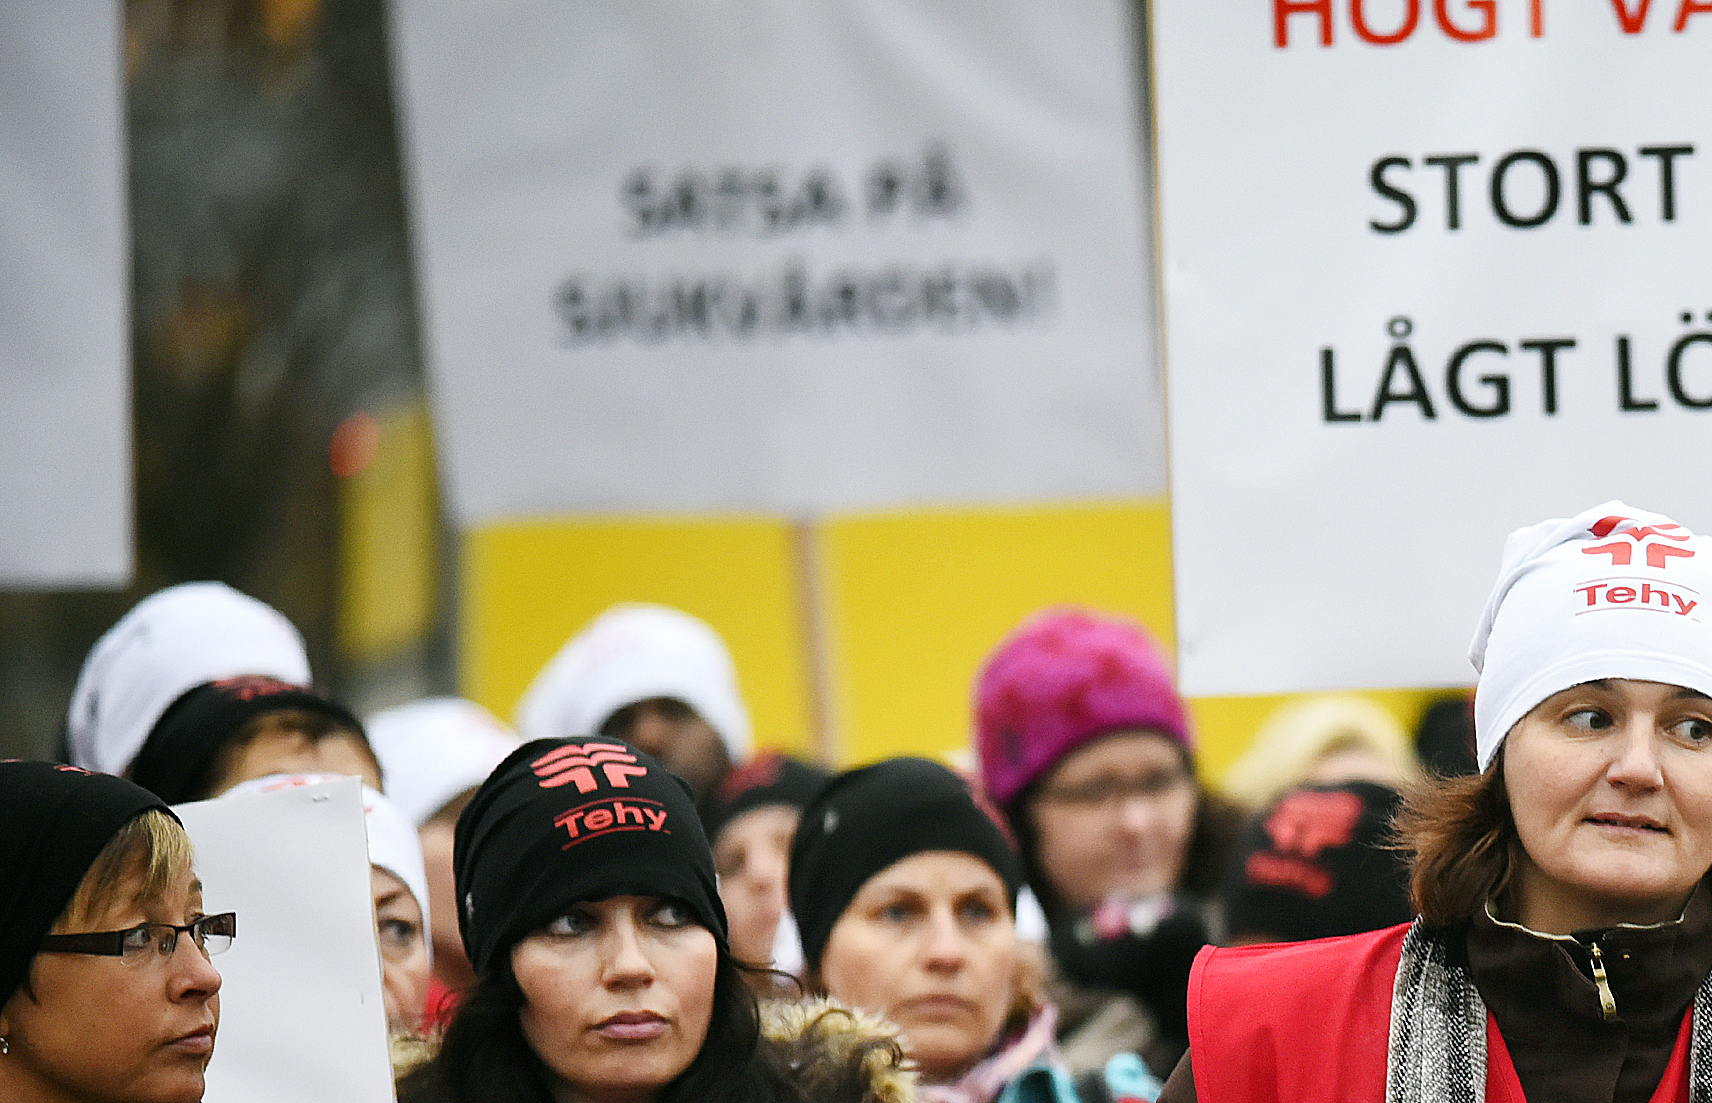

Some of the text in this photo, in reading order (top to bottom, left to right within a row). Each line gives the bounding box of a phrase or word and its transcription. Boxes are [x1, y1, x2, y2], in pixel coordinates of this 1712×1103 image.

[1369, 144, 1695, 233] STORT
[1319, 315, 1577, 422] LÅGT
[1575, 583, 1697, 616] Tehy
[554, 801, 667, 838] Tehy
